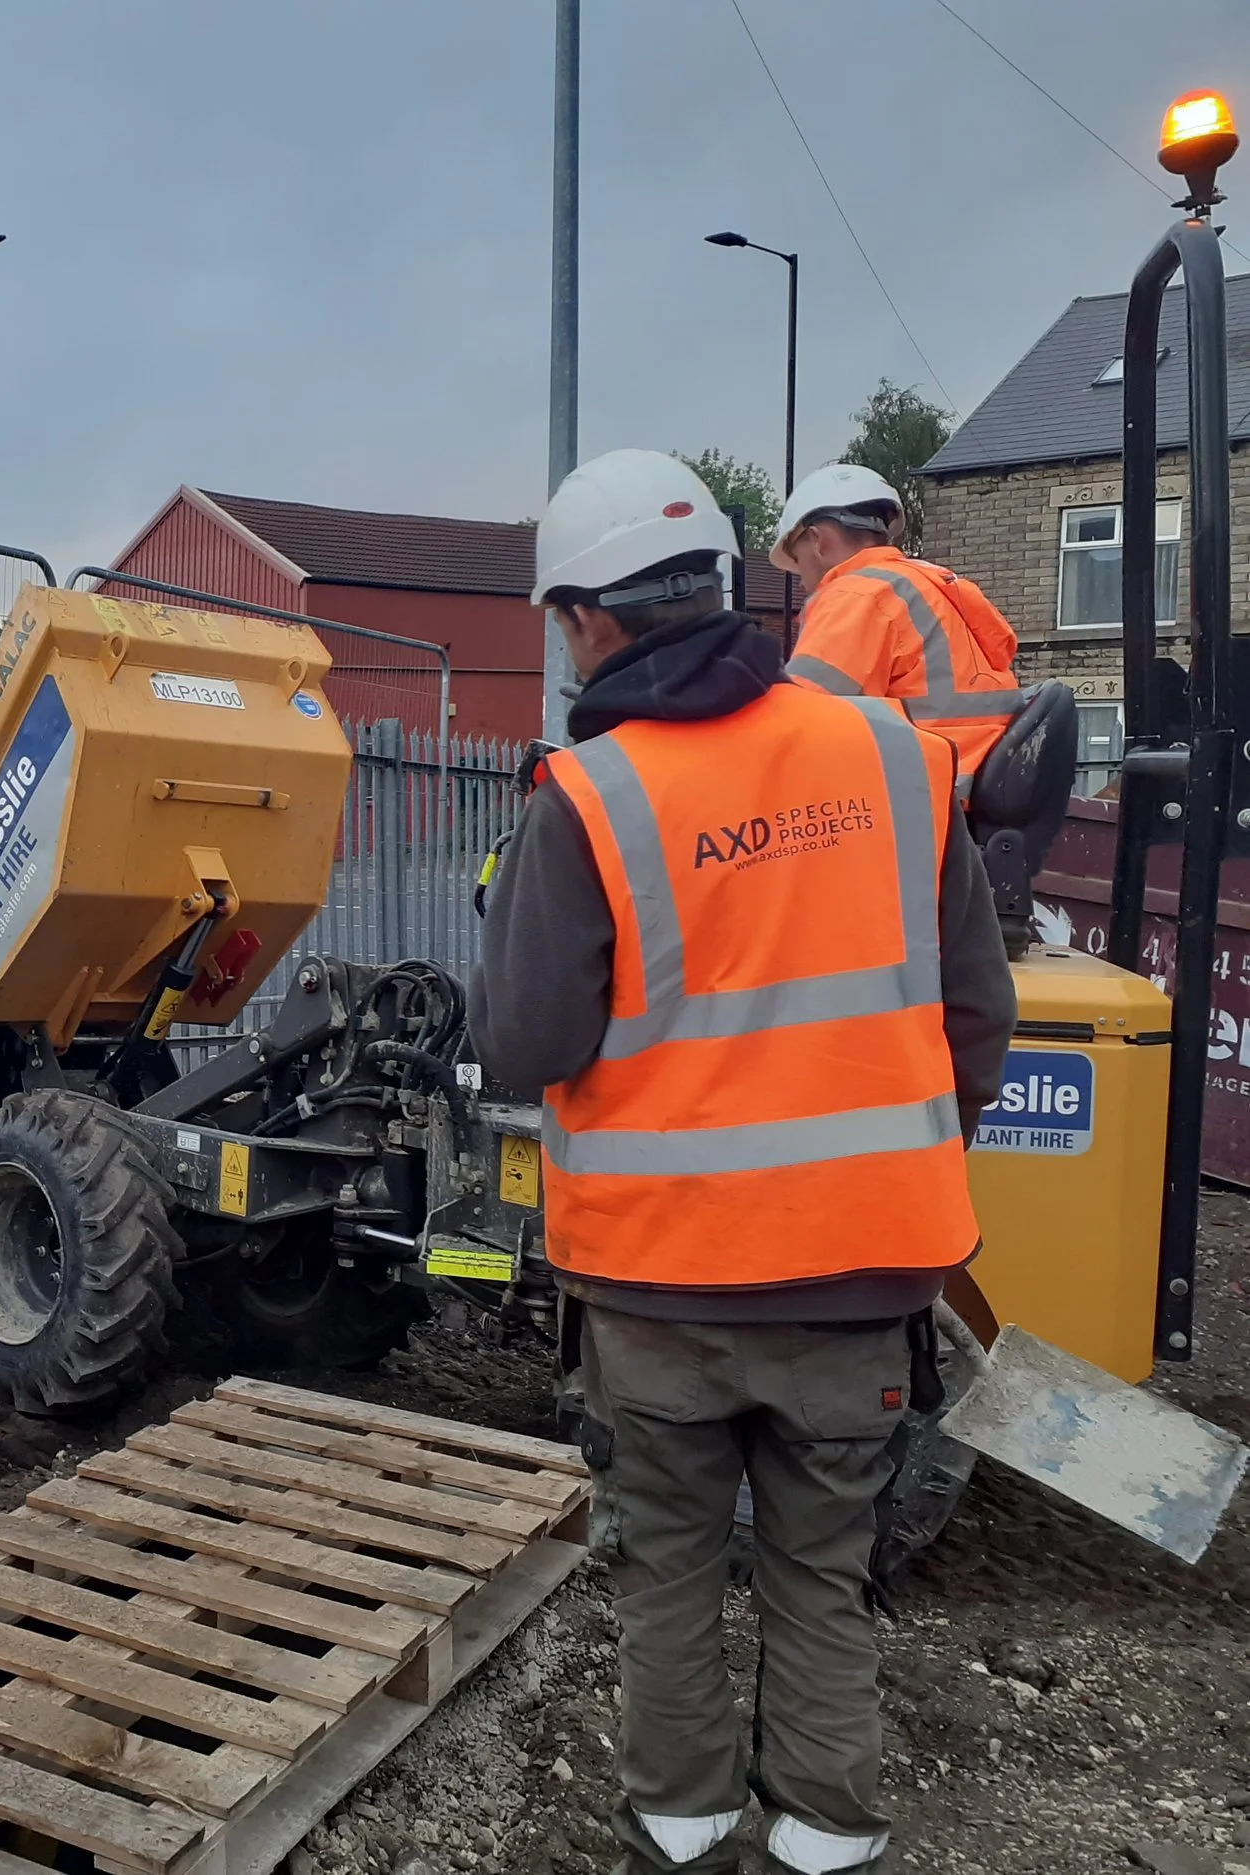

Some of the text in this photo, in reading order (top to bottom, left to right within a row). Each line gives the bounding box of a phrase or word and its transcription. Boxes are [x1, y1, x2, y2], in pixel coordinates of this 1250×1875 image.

[152, 681, 243, 707] MLP13100
[775, 798, 872, 826] SPECIAL
[694, 817, 771, 869] AXD
[779, 815, 873, 843] PROJECTS
[734, 836, 840, 871] wwaxdsp.co.uk
[981, 1075, 1080, 1115] slie
[975, 1127, 1074, 1149] LANT HIRE
